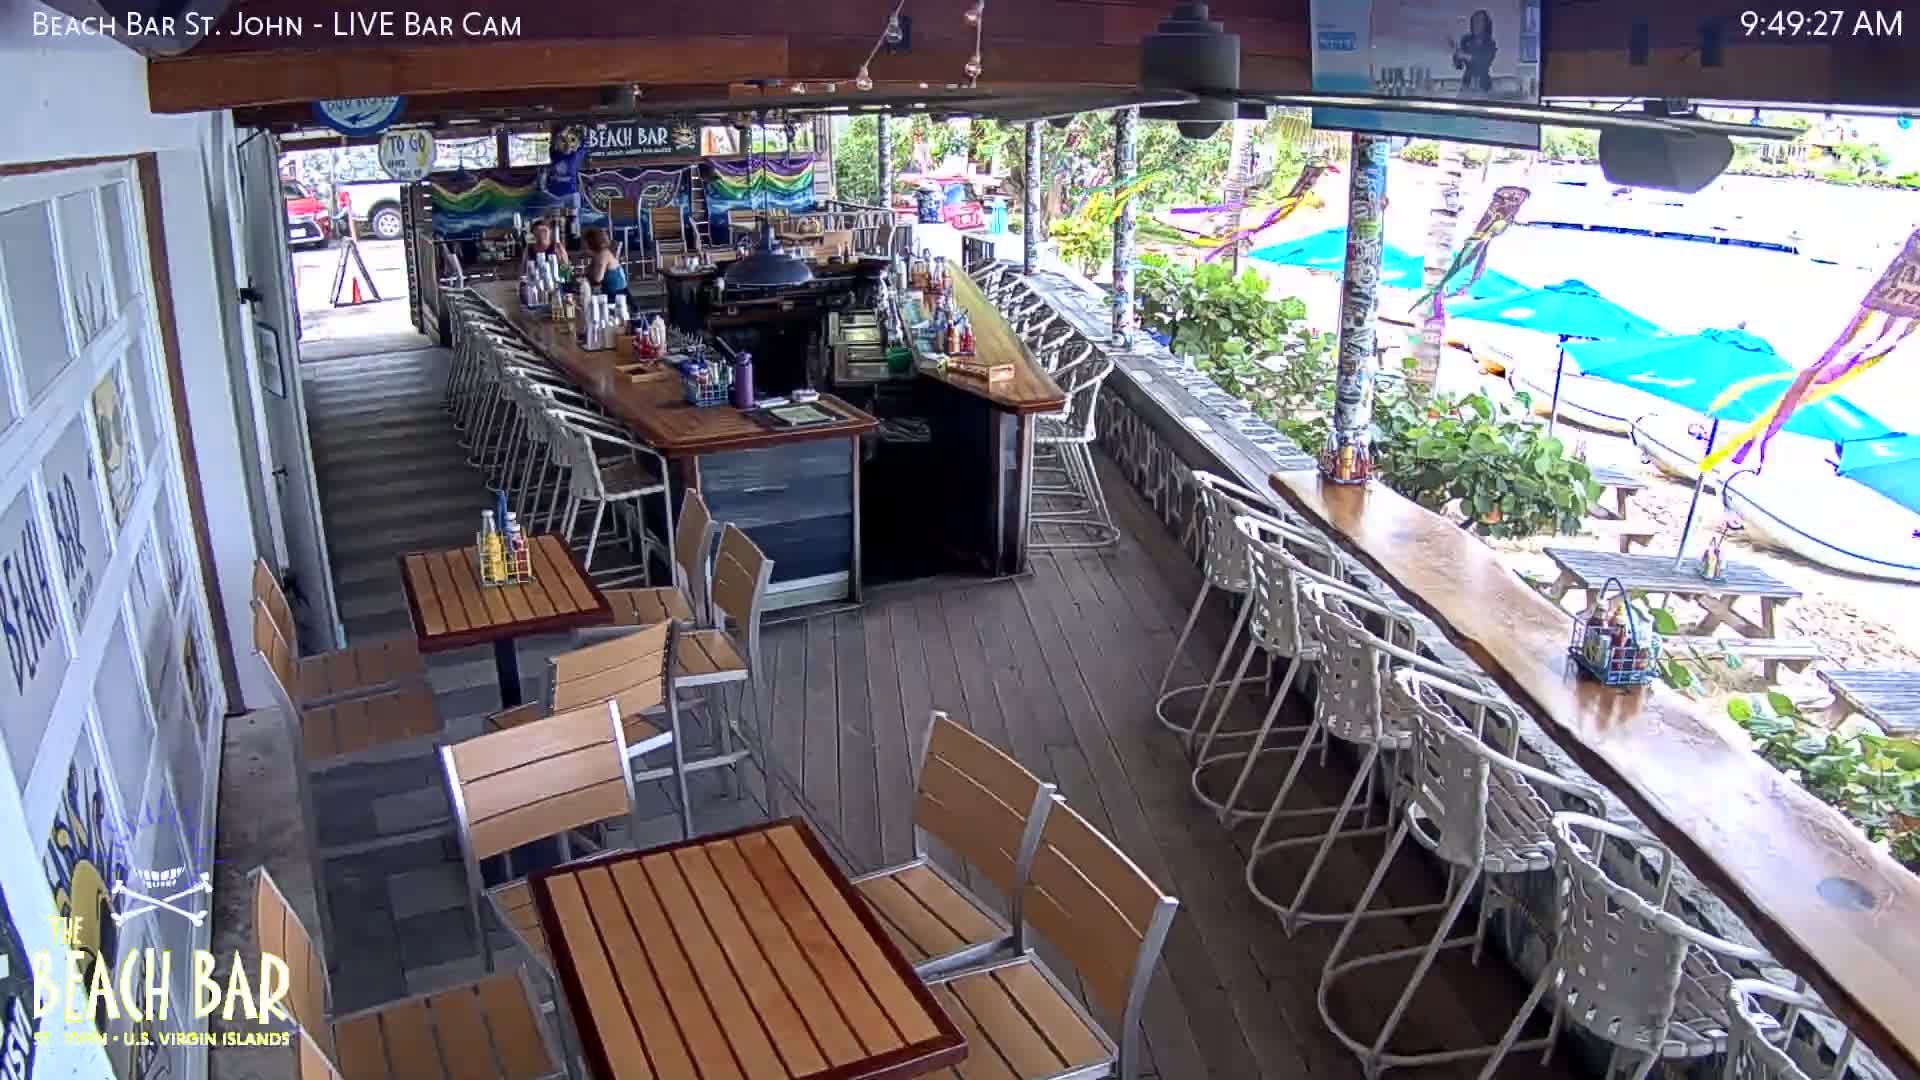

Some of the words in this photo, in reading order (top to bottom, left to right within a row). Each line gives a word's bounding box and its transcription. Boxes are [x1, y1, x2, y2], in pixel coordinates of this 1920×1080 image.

[386, 135, 405, 156] TO
[408, 133, 426, 153] GO
[589, 127, 633, 148] BEACH
[638, 126, 669, 146] BAR
